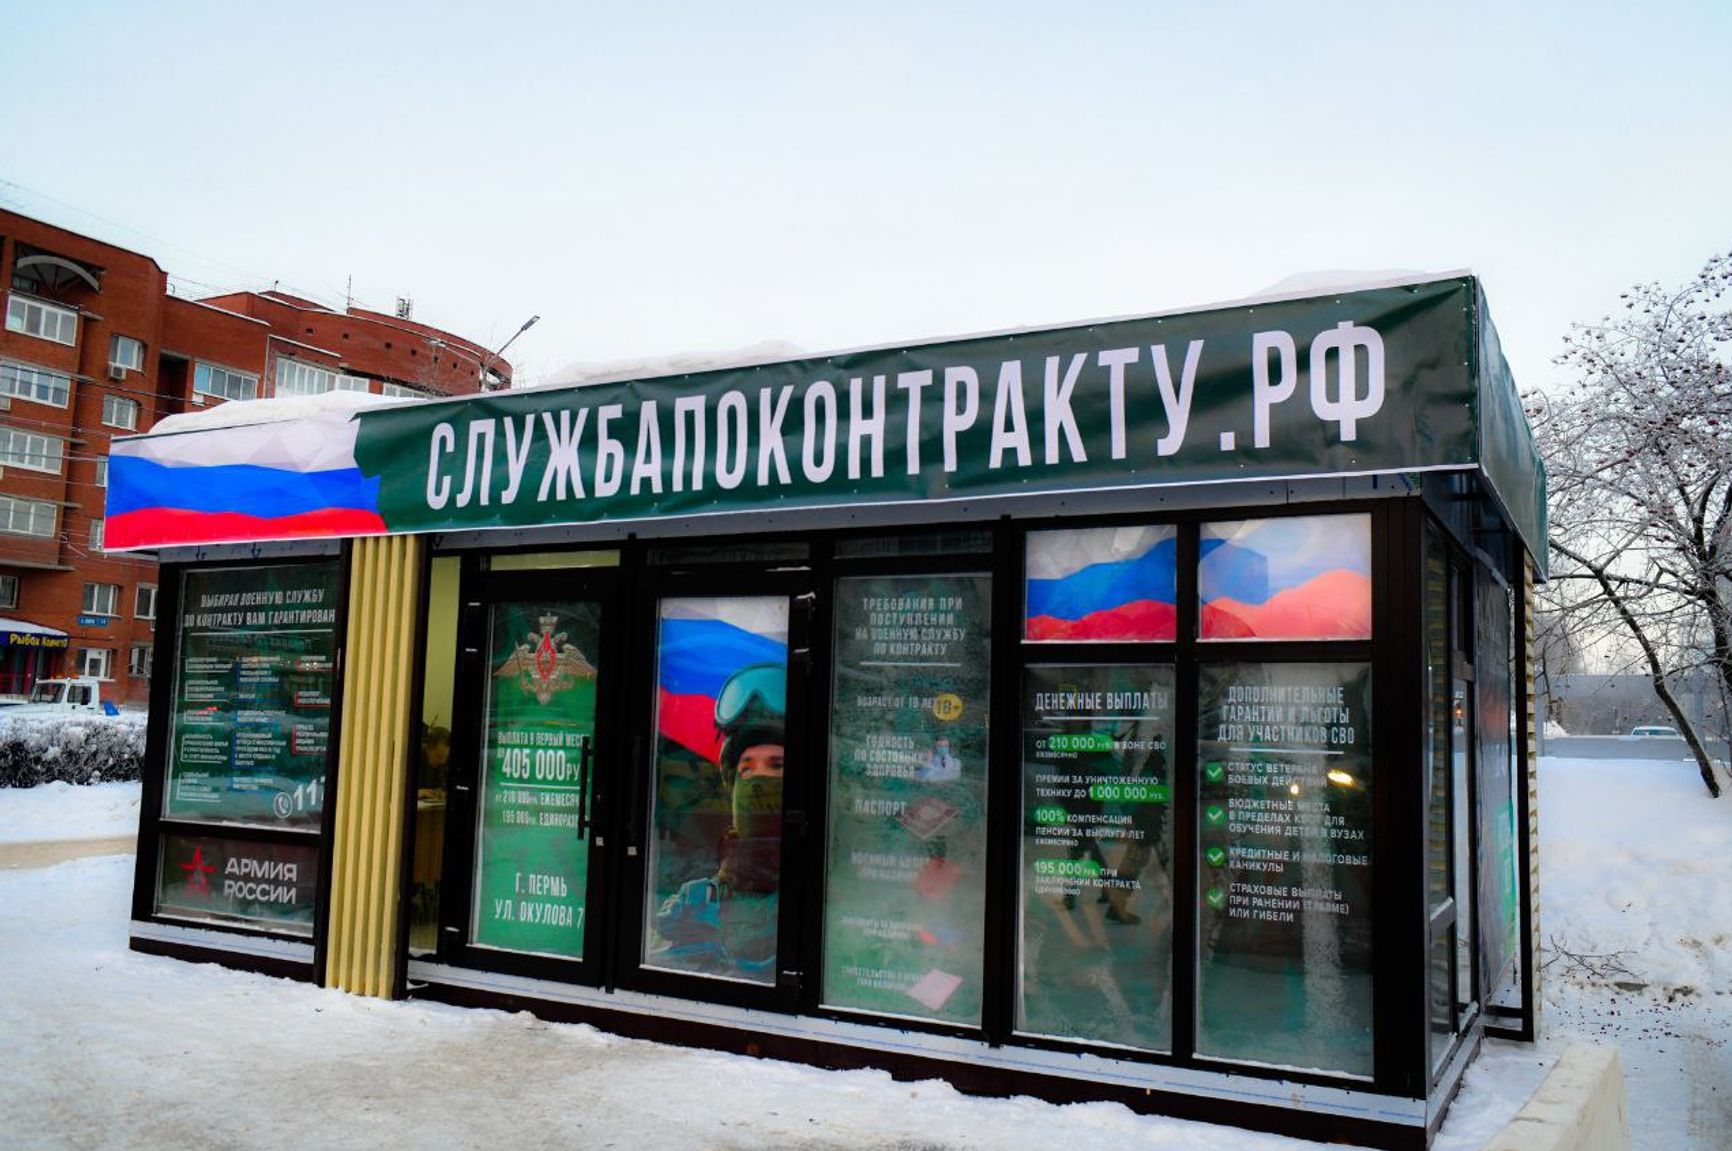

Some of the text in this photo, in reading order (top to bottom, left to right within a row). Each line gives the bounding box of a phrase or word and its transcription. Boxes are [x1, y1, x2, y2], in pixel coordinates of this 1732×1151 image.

[426, 320, 1386, 510] СЛУЖБАПОКОНТРАКТУ.РФ
[285, 588, 325, 604] СЛУЖБУ
[862, 597, 963, 611] ТРЕБОВАНИЯ ПРИ
[196, 612, 243, 627] КОНТРАКТУ
[246, 611, 265, 626] ВАМ
[870, 612, 954, 625] ПОСТУПЛЕНИИ
[855, 627, 967, 641] НА ВОЕННУЮ СЛУЖБУ
[873, 642, 948, 656] ПО КОНТРАКТУ
[1034, 691, 1169, 711] ДЕНЕЖНЫЕ ВЫПЛАТЫ
[1227, 685, 1344, 705] ДОПОЛНИТЕЛЬНЫЕ
[1222, 705, 1349, 724] ГАРАНТИИ И ЛЬГОТЫ
[535, 731, 564, 747] ПЕРВЫЙ
[866, 735, 915, 748] ГОДНОСТЬ
[1217, 724, 1355, 745] ДЛЯ УЧАСТНИКОВ СВО
[1035, 740, 1047, 749] ОТ
[1048, 737, 1067, 749] 210
[1071, 737, 1094, 749] 000
[1122, 741, 1146, 750] ЗОНЕ
[1147, 741, 1167, 750] СВО
[854, 748, 867, 761] ПО
[502, 748, 530, 779] 405
[535, 748, 566, 781] 000
[865, 763, 915, 777] ЗДОРОВЬЯ
[1227, 761, 1263, 773] СТАТУС
[1071, 775, 1083, 785] ЗА
[1085, 775, 1159, 785] УНИЧТОЖЕННУЮ
[1227, 774, 1268, 786] БОЕВЫХ
[1035, 787, 1072, 798] ТЕХНИКУ
[1073, 788, 1086, 799] ДО
[1096, 786, 1120, 799] 000
[1124, 786, 1147, 799] 000
[855, 798, 907, 816] ПАСПОРТ
[1228, 798, 1293, 811] БЮДЖЕТНЫЕ
[1035, 808, 1133, 825] 100% КОМПЕНСАЦИЯ
[1237, 811, 1290, 824] ПРЕДЕЛАХ
[1324, 815, 1344, 827] ДЛЯ
[1071, 828, 1084, 837] ЗА
[1128, 829, 1145, 840] ЛЕТ
[1228, 823, 1281, 835] ОБУЧЕНИЯ
[1329, 829, 1364, 841] ВУЗАХ
[1228, 848, 1288, 861] КРЕДИТНЫЕ
[1292, 851, 1299, 861] И
[224, 856, 298, 882] АРМИЯ
[1035, 861, 1055, 874] 195
[1058, 862, 1081, 875] 000
[1100, 868, 1118, 878] ПРИ
[1228, 860, 1284, 873] КАНИКУЛЫ
[515, 872, 567, 897] Г. ПЕРМЬ
[1092, 879, 1143, 890] КОНТРАКТА
[1228, 883, 1288, 897] СТРАХОВЫЕ
[224, 880, 297, 905] РОССИИ
[1228, 895, 1248, 906] ПРИ
[1251, 897, 1299, 909] РАНЕНИИ
[494, 897, 515, 920] УЛ.
[520, 900, 573, 928] ОКУЛОВА
[1228, 907, 1293, 922] ИЛИ ГИБЕЛИ
